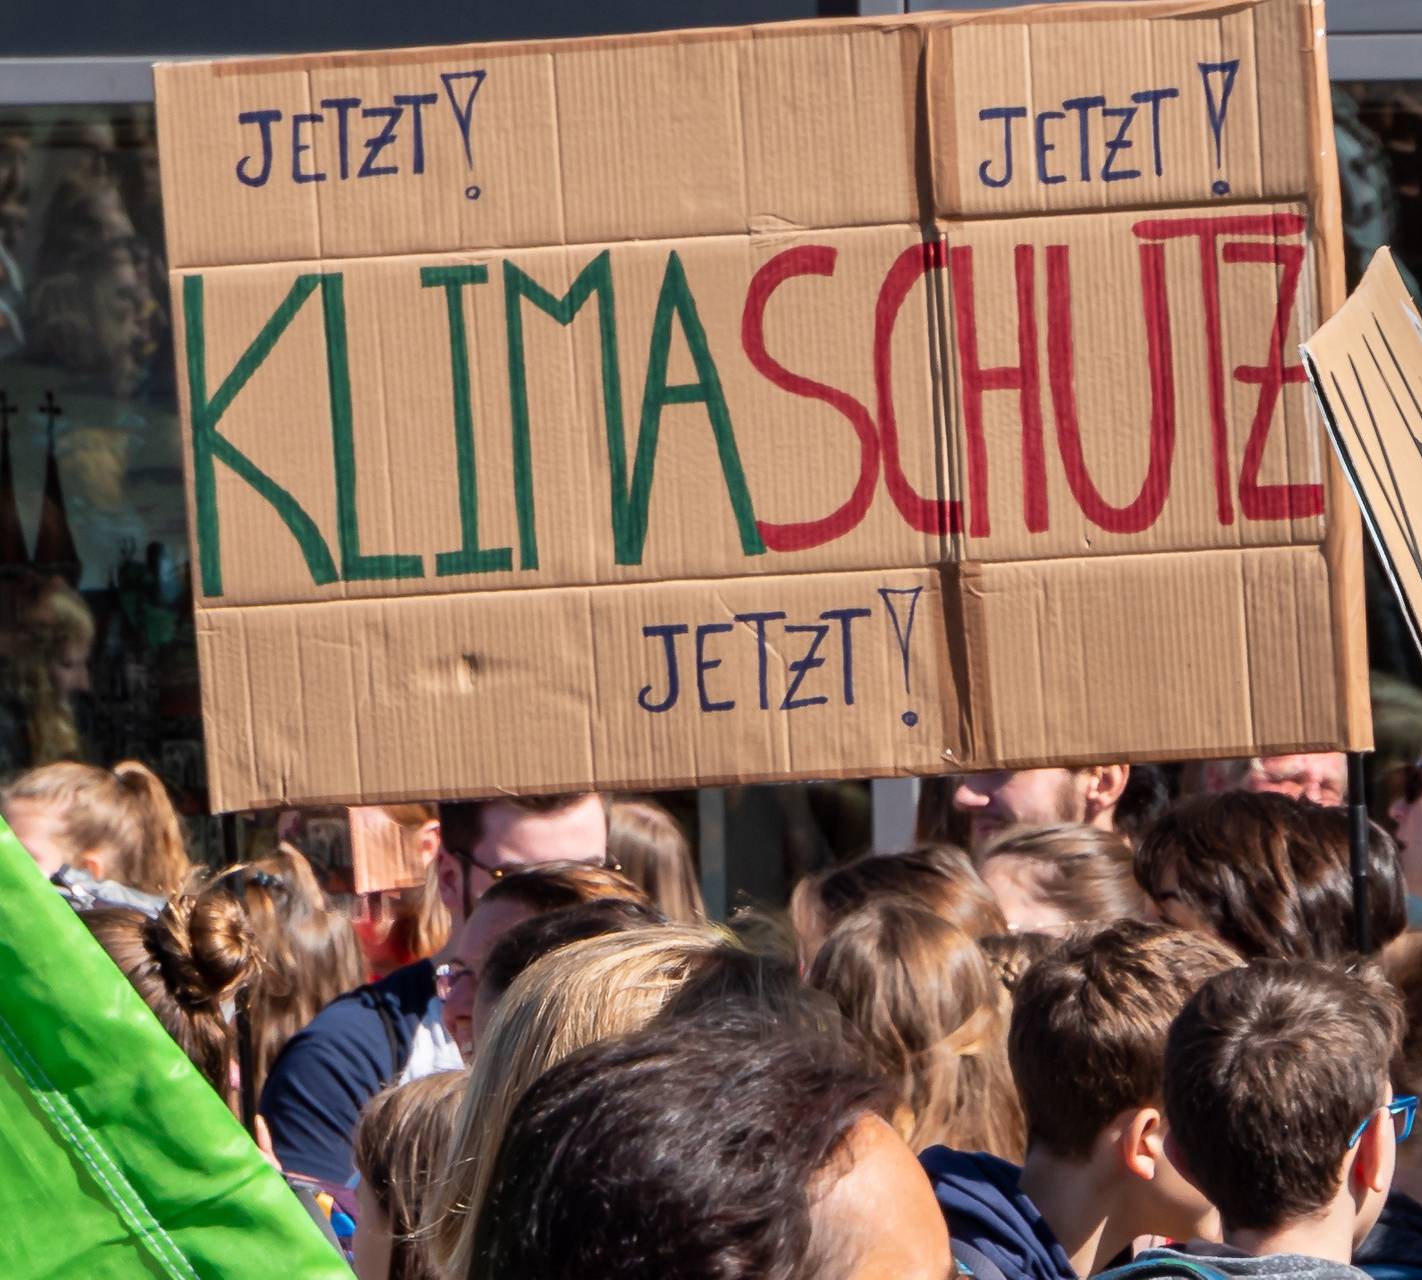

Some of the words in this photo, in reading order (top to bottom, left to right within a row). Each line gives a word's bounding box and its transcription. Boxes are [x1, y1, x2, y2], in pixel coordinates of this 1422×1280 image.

[235, 70, 487, 200] JETZT!
[183, 213, 1325, 597] KLIMASCHUTZ
[637, 586, 923, 728] JETZT!
